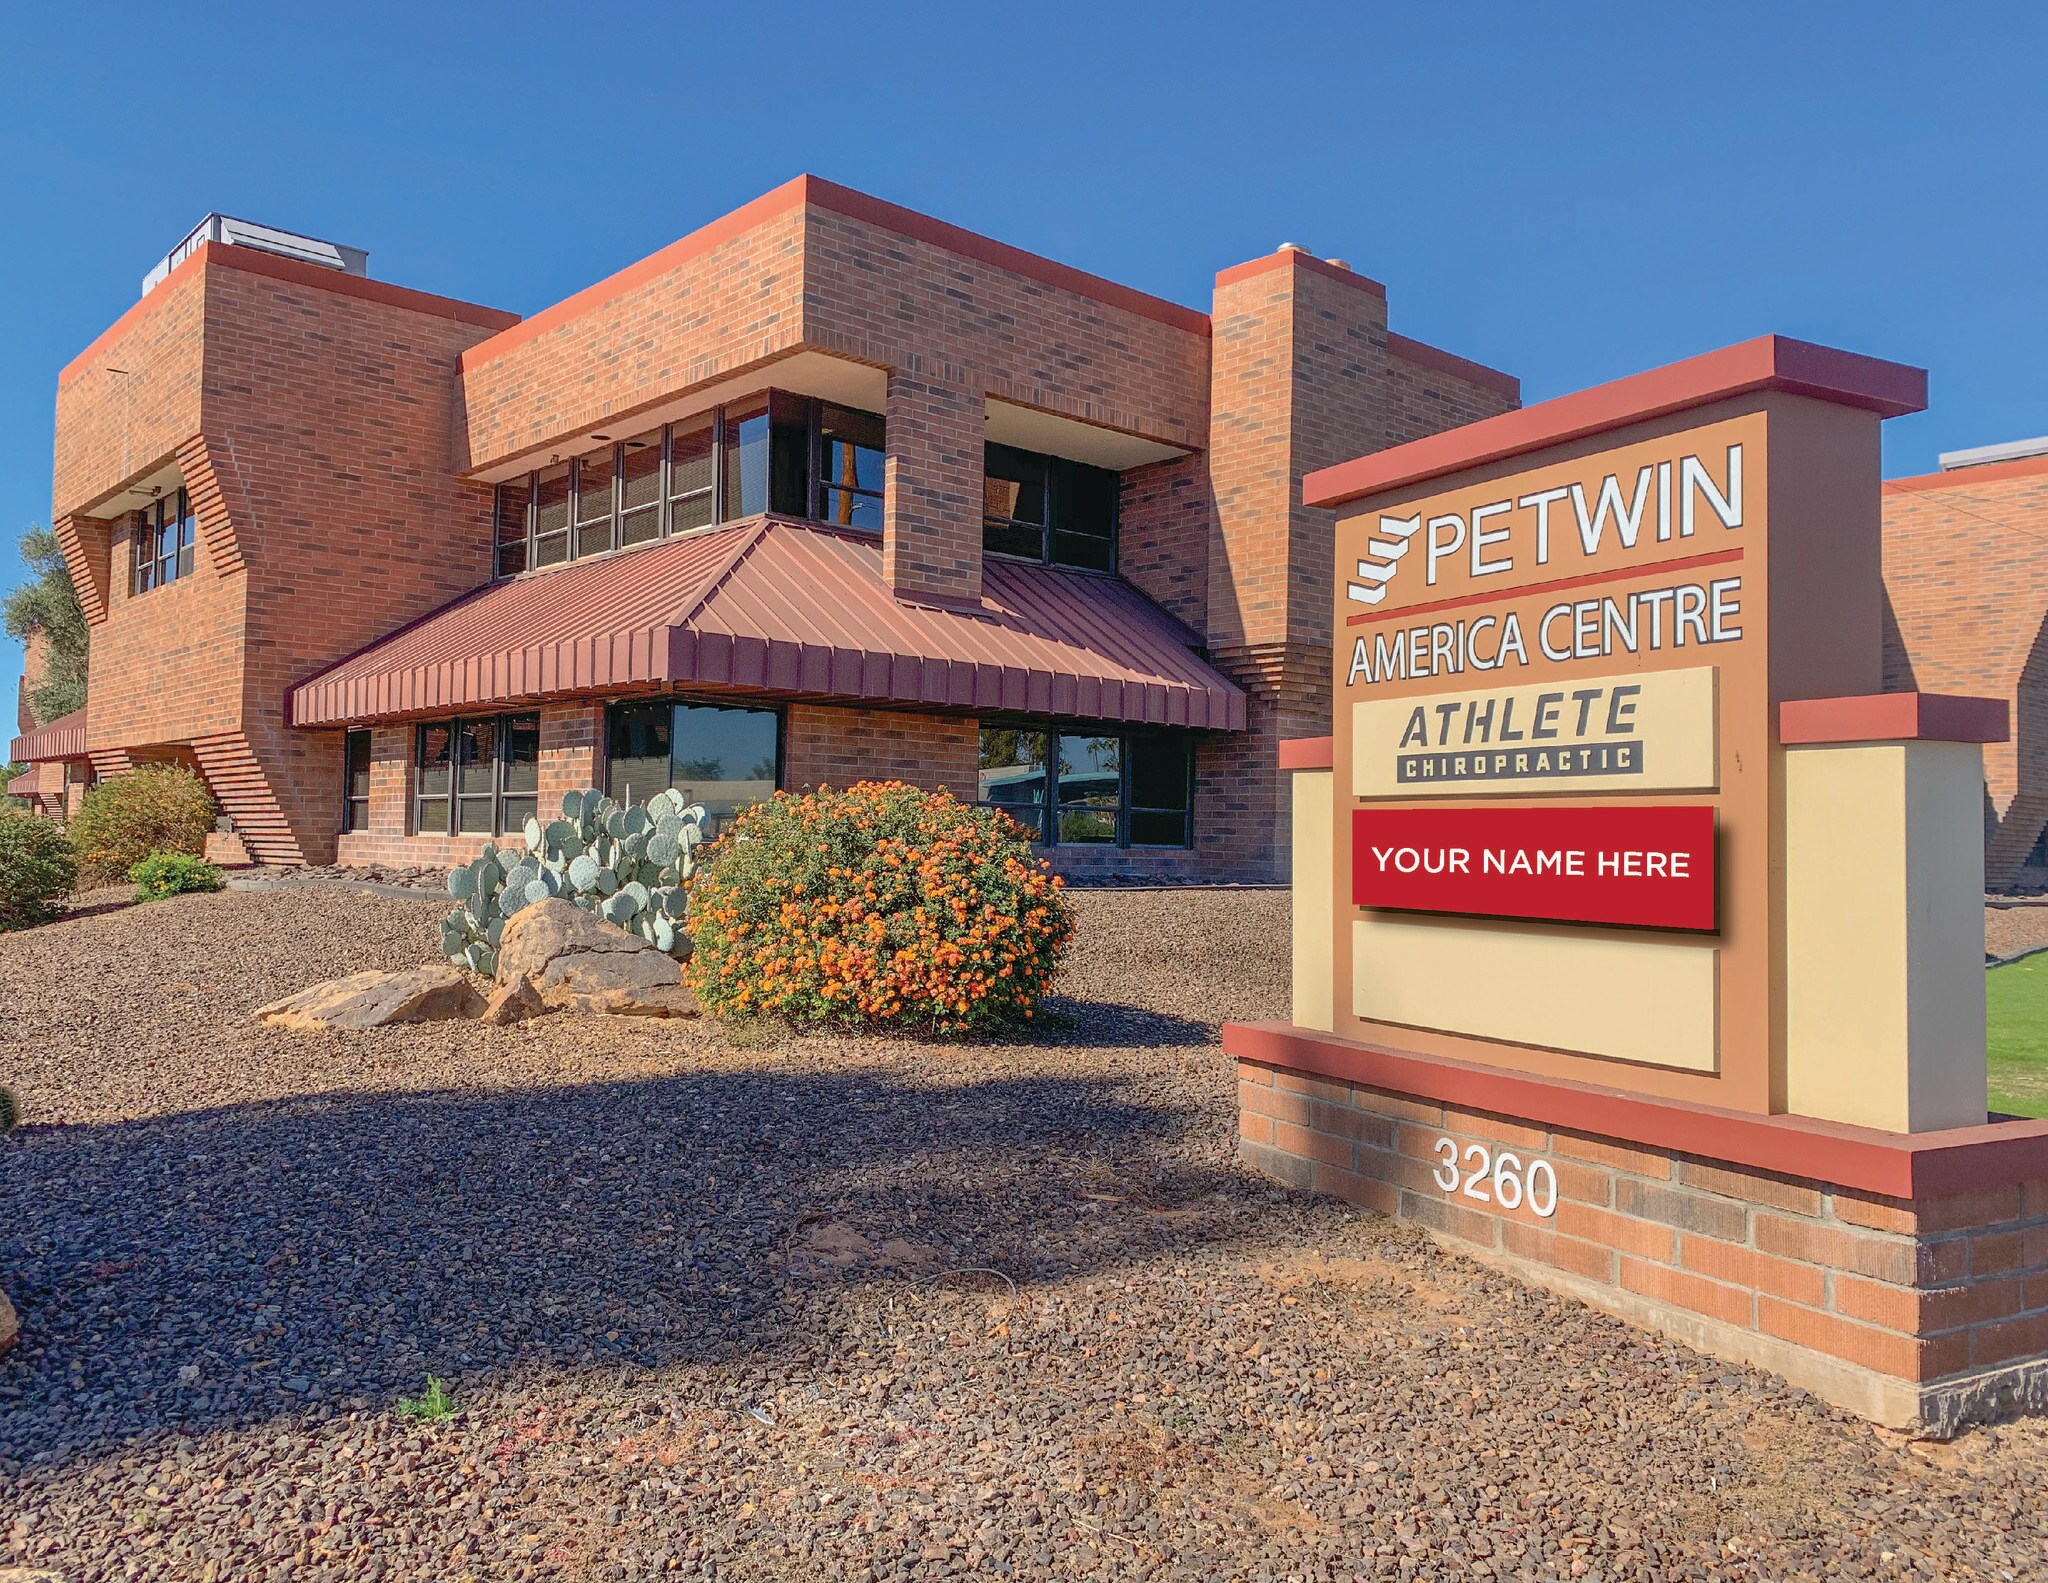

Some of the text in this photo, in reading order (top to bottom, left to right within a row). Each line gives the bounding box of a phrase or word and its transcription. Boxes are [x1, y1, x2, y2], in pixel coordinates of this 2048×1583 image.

[1426, 443, 1743, 585] PETWIN
[1346, 577, 1742, 686] AMERICA CENTRE
[1399, 684, 1641, 748] ATHLETE
[1406, 748, 1631, 777] CHIROPRACTIC
[1371, 846, 1690, 878] YOUR NAME HERE
[1433, 1137, 1557, 1217] 3260
